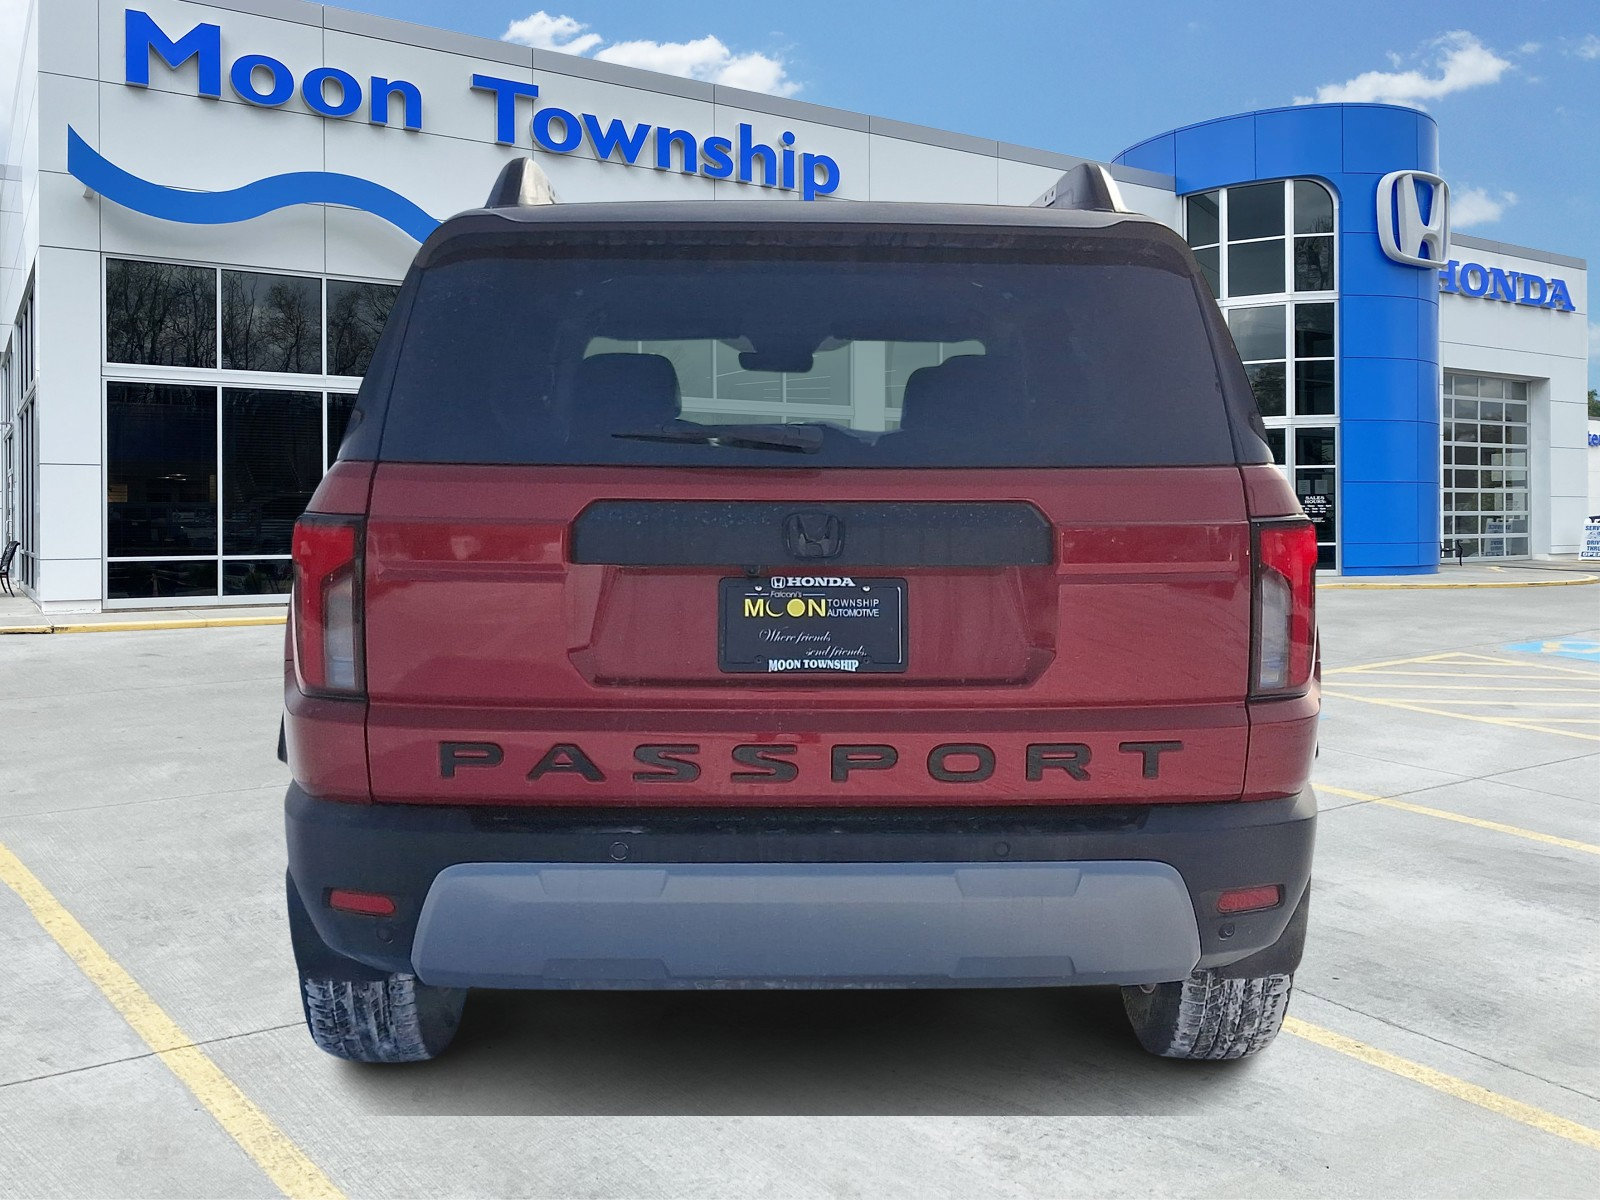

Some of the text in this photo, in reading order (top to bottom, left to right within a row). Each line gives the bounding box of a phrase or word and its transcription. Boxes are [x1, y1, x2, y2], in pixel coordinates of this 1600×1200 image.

[125, 8, 841, 201] Moon Township
[787, 577, 856, 587] HONDA
[827, 599, 880, 607] TOWNSHIP
[826, 608, 880, 618] AUTOMOTIVE
[759, 629, 831, 644] Where friends
[805, 646, 831, 656] send
[768, 659, 859, 673] MOON TOWNSHIP
[439, 741, 1183, 784] PASSPORT
